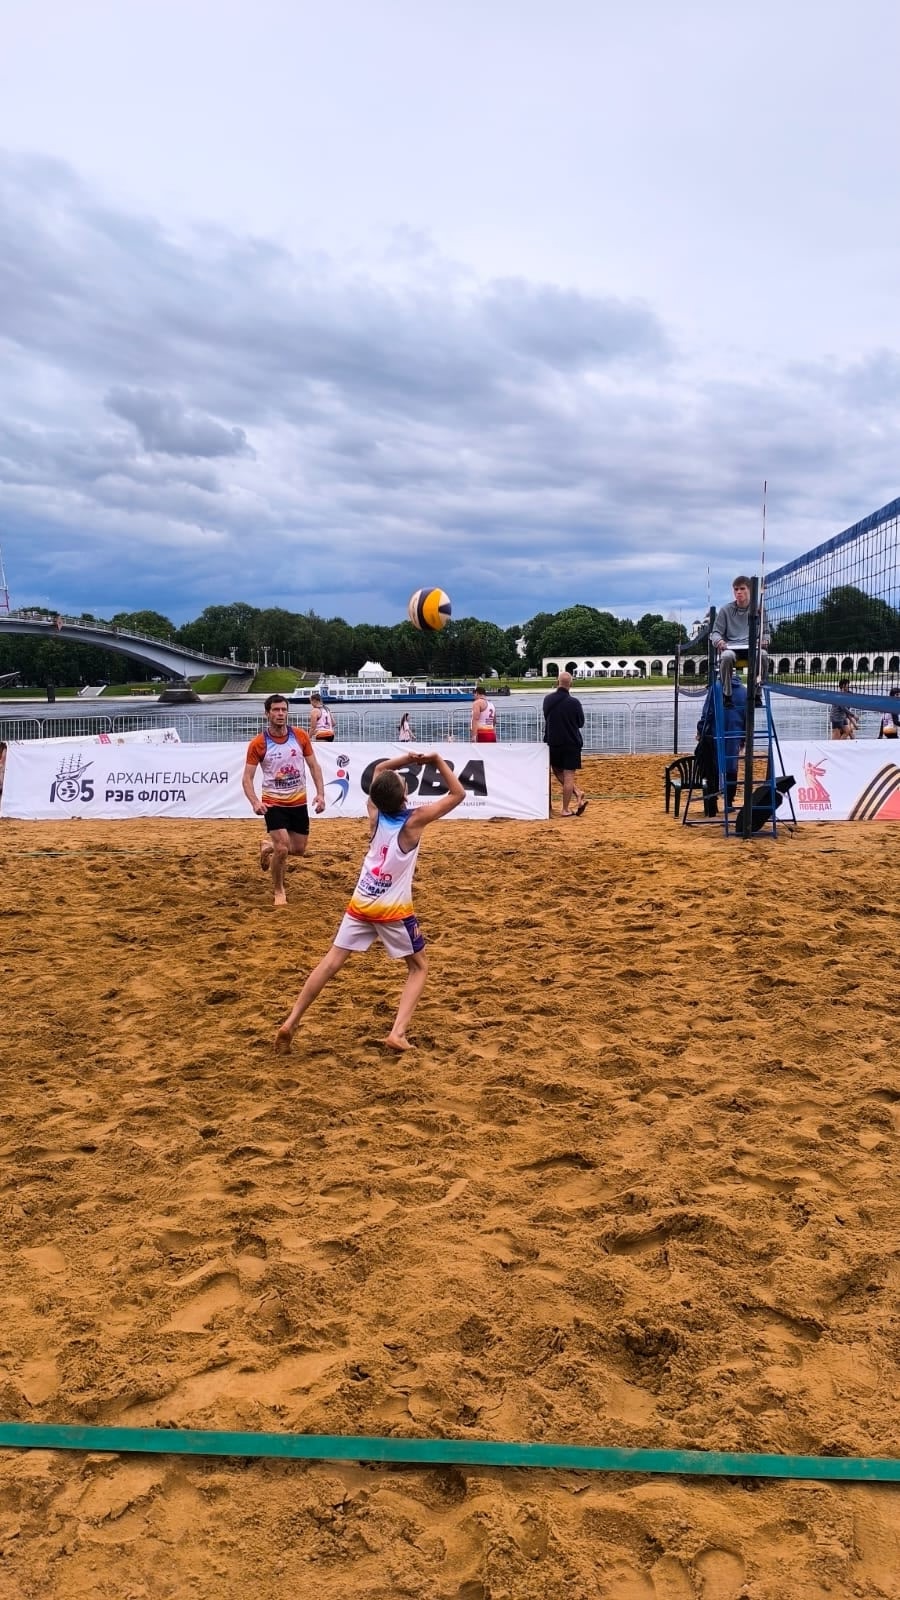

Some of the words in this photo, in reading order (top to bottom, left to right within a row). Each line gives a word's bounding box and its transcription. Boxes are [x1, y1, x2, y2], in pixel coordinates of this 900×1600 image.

[291, 749, 297, 757] 2
[107, 772, 228, 785] АРХАНГЕЛЬСКАЯ
[105, 789, 134, 802] РЭБ
[137, 789, 187, 802] ФЛОТА
[798, 787, 815, 801] 80
[799, 802, 832, 811] ПОБЕДА!
